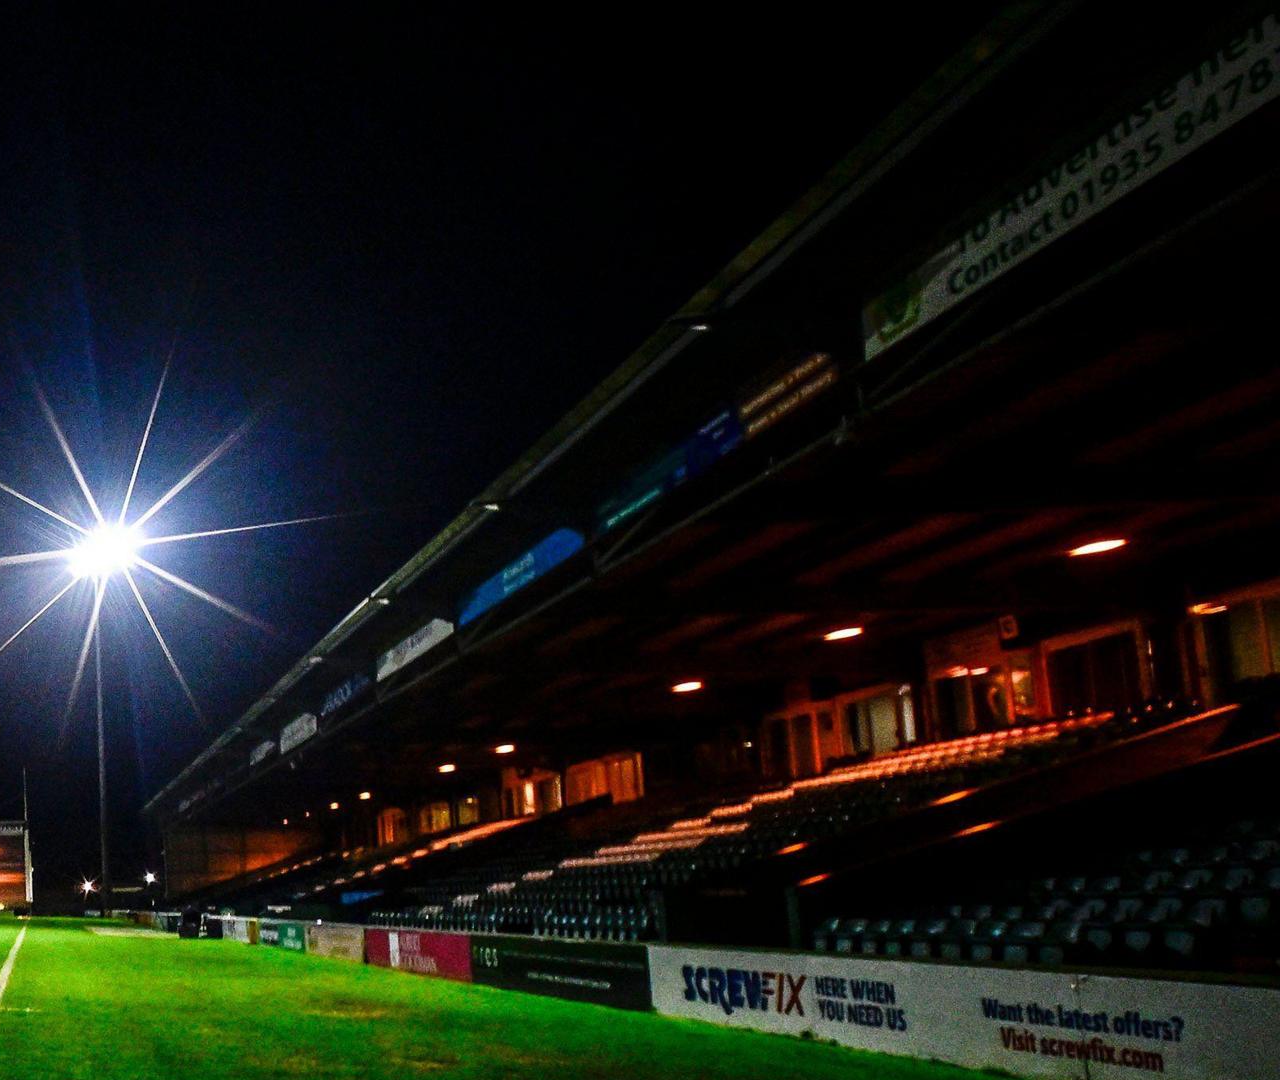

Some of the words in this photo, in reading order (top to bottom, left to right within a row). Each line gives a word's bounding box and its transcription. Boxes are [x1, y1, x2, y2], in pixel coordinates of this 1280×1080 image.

[948, 210, 1054, 294] Contact
[1061, 132, 1164, 219] 01935
[1175, 44, 1280, 144] 8478
[682, 964, 807, 1017] SCREWFIX
[815, 976, 847, 999] HERE
[850, 979, 896, 1004] WHEN
[818, 999, 845, 1023] YOU
[848, 1003, 884, 1027] NEED
[887, 1007, 907, 1031] US
[981, 998, 1024, 1022] Want
[1026, 1003, 1055, 1026] the
[1057, 1004, 1109, 1033] latest
[1113, 1010, 1184, 1042] offers?
[999, 1026, 1037, 1053] Visit
[1040, 1037, 1164, 1073] screwfix.com
